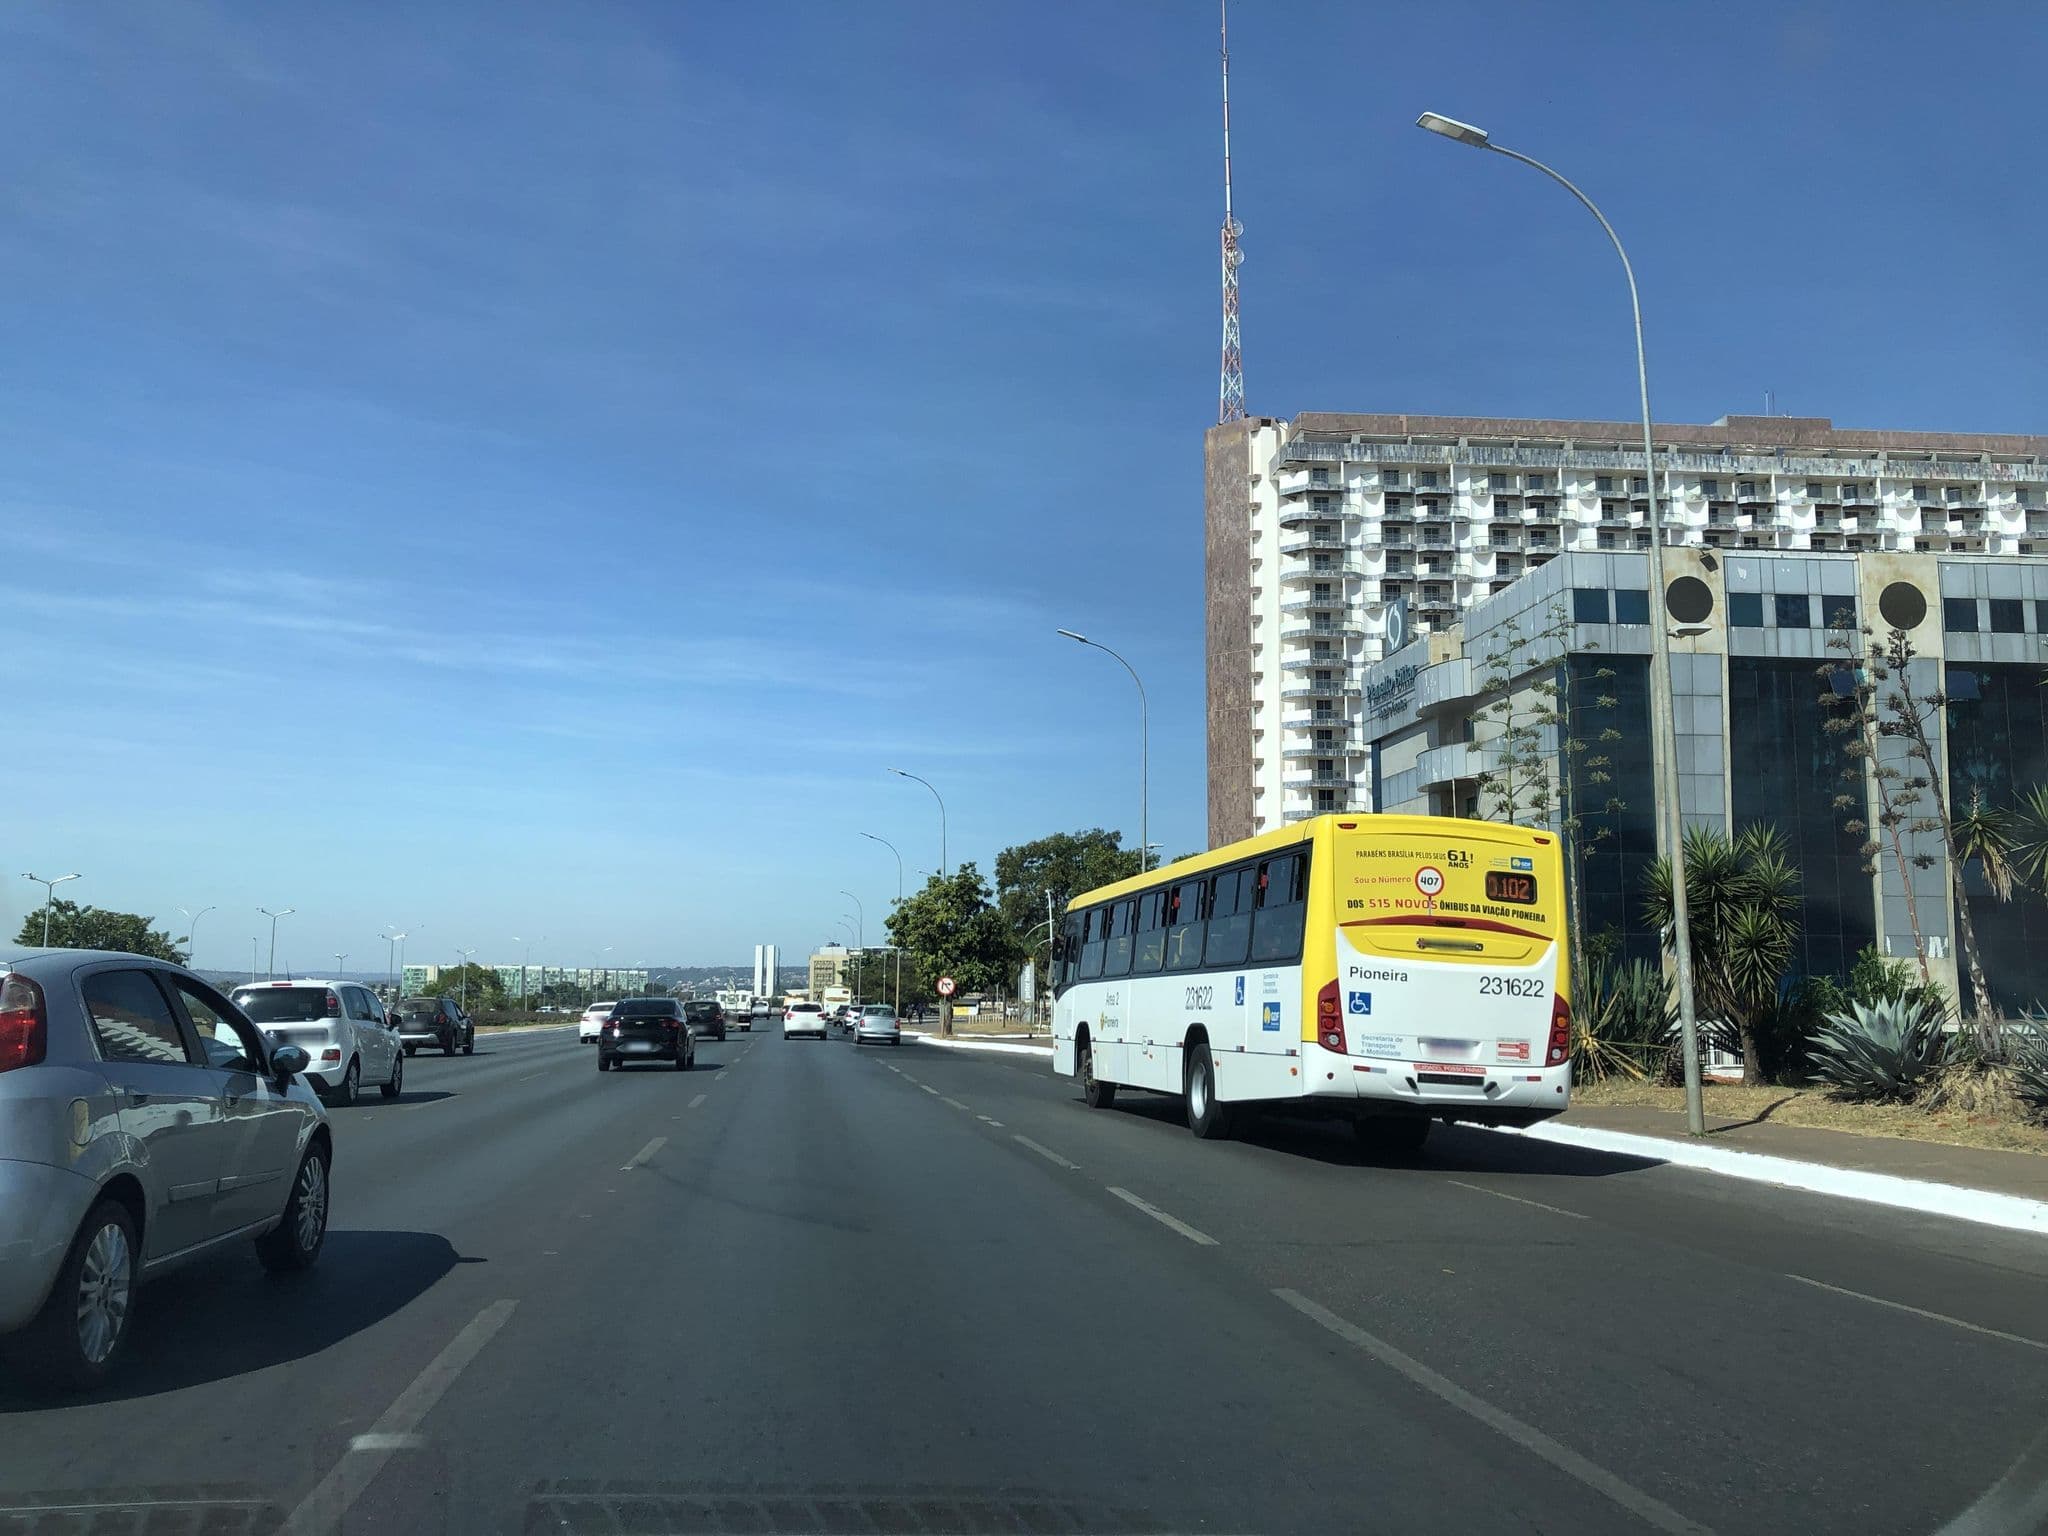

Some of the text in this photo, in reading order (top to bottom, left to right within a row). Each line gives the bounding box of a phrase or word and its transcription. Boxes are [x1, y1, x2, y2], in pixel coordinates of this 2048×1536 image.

[1356, 849, 1386, 858] PARABÉNS
[1388, 849, 1414, 858] BRASÍLIA
[1415, 851, 1432, 860] PELOS
[1433, 852, 1446, 860] SEUS
[1448, 861, 1469, 869] ANOS
[1354, 876, 1370, 884] Sou
[1378, 875, 1412, 884] Número
[1420, 877, 1439, 886] 407
[1347, 898, 1546, 923] DOS 515 NOVOS ÔNIBUS DA VIAÇÃO PIONEIRA
[1350, 966, 1408, 982] Pioneira
[1479, 976, 1545, 998] 231622
[1185, 986, 1213, 1010] 231622
